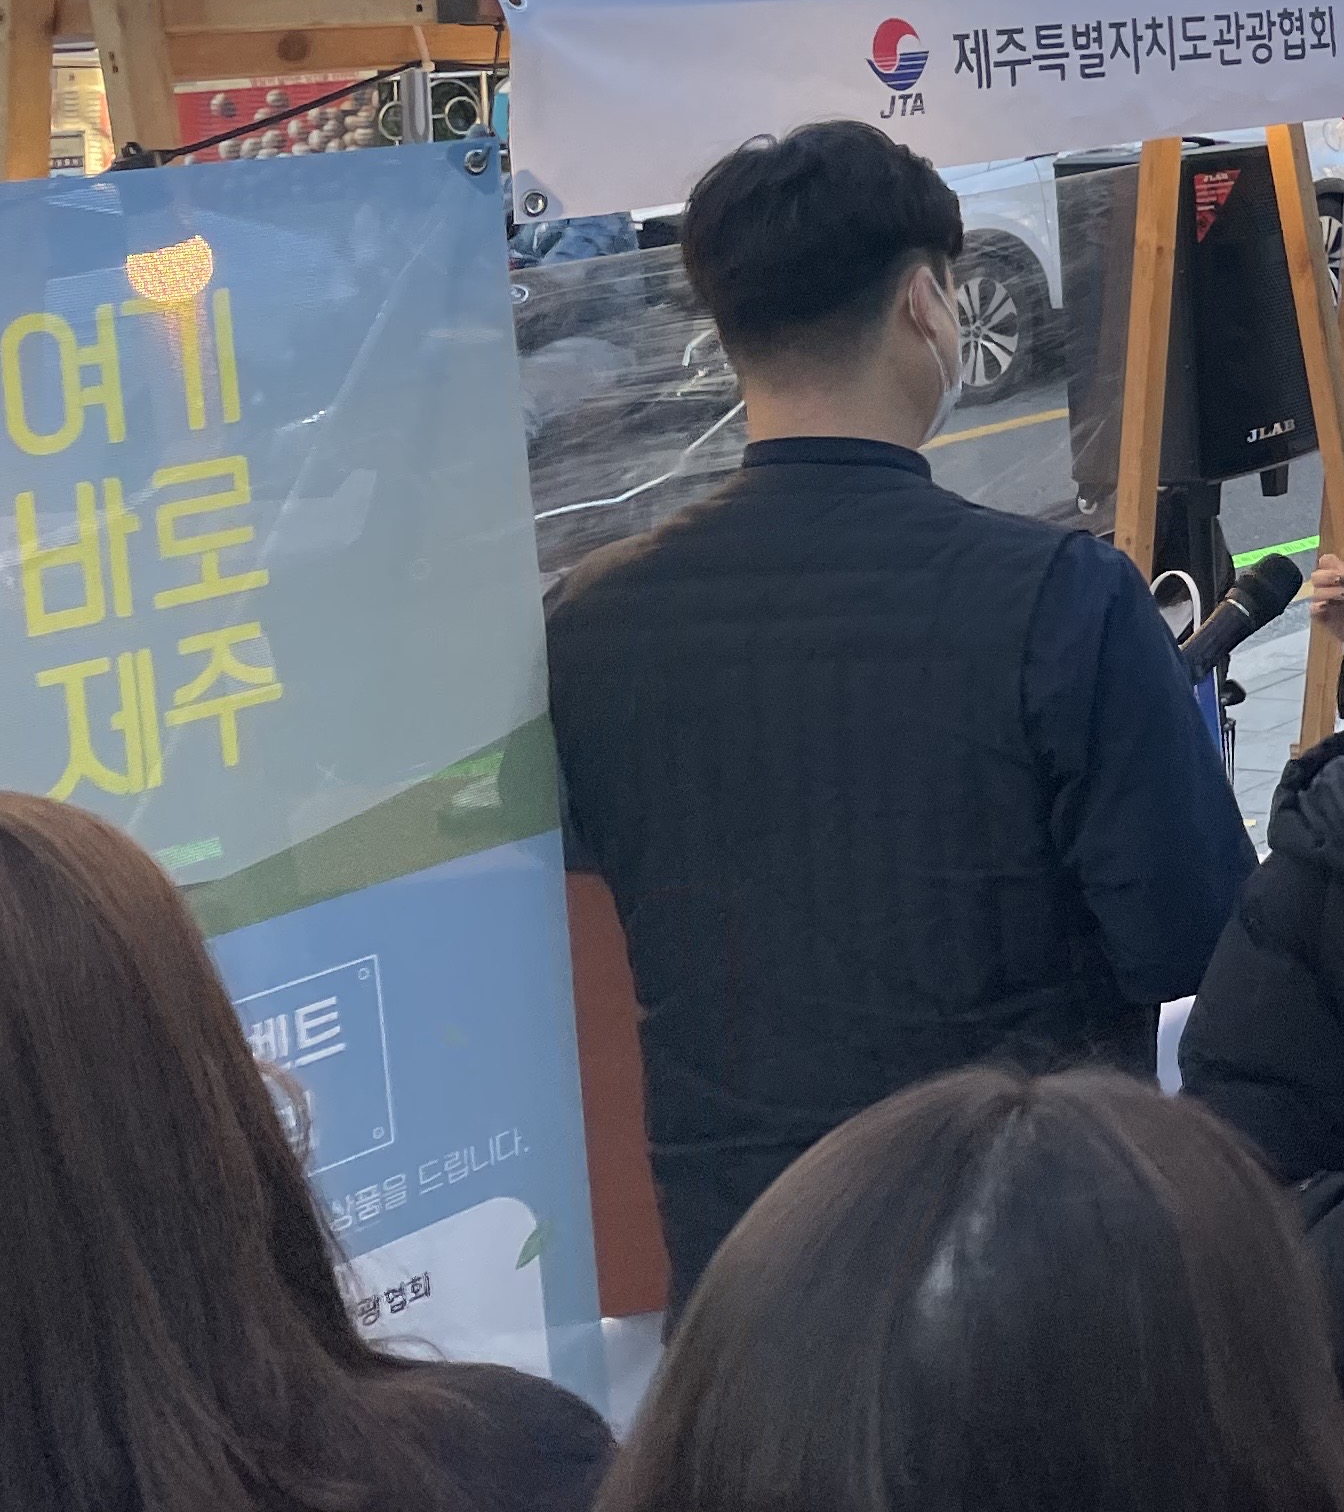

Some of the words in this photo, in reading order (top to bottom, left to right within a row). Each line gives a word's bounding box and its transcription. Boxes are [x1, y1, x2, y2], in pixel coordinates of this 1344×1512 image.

[951, 5, 1339, 90] 제주특별자치도관광협회
[879, 91, 927, 120] JTA
[1, 287, 241, 456] 여기
[1246, 418, 1297, 444] JLAB
[14, 455, 271, 637] 바로
[35, 621, 284, 802] 제주
[247, 995, 348, 1070] 벤트
[417, 1126, 531, 1196] 드립니다.
[356, 1270, 432, 1327] 광협회
